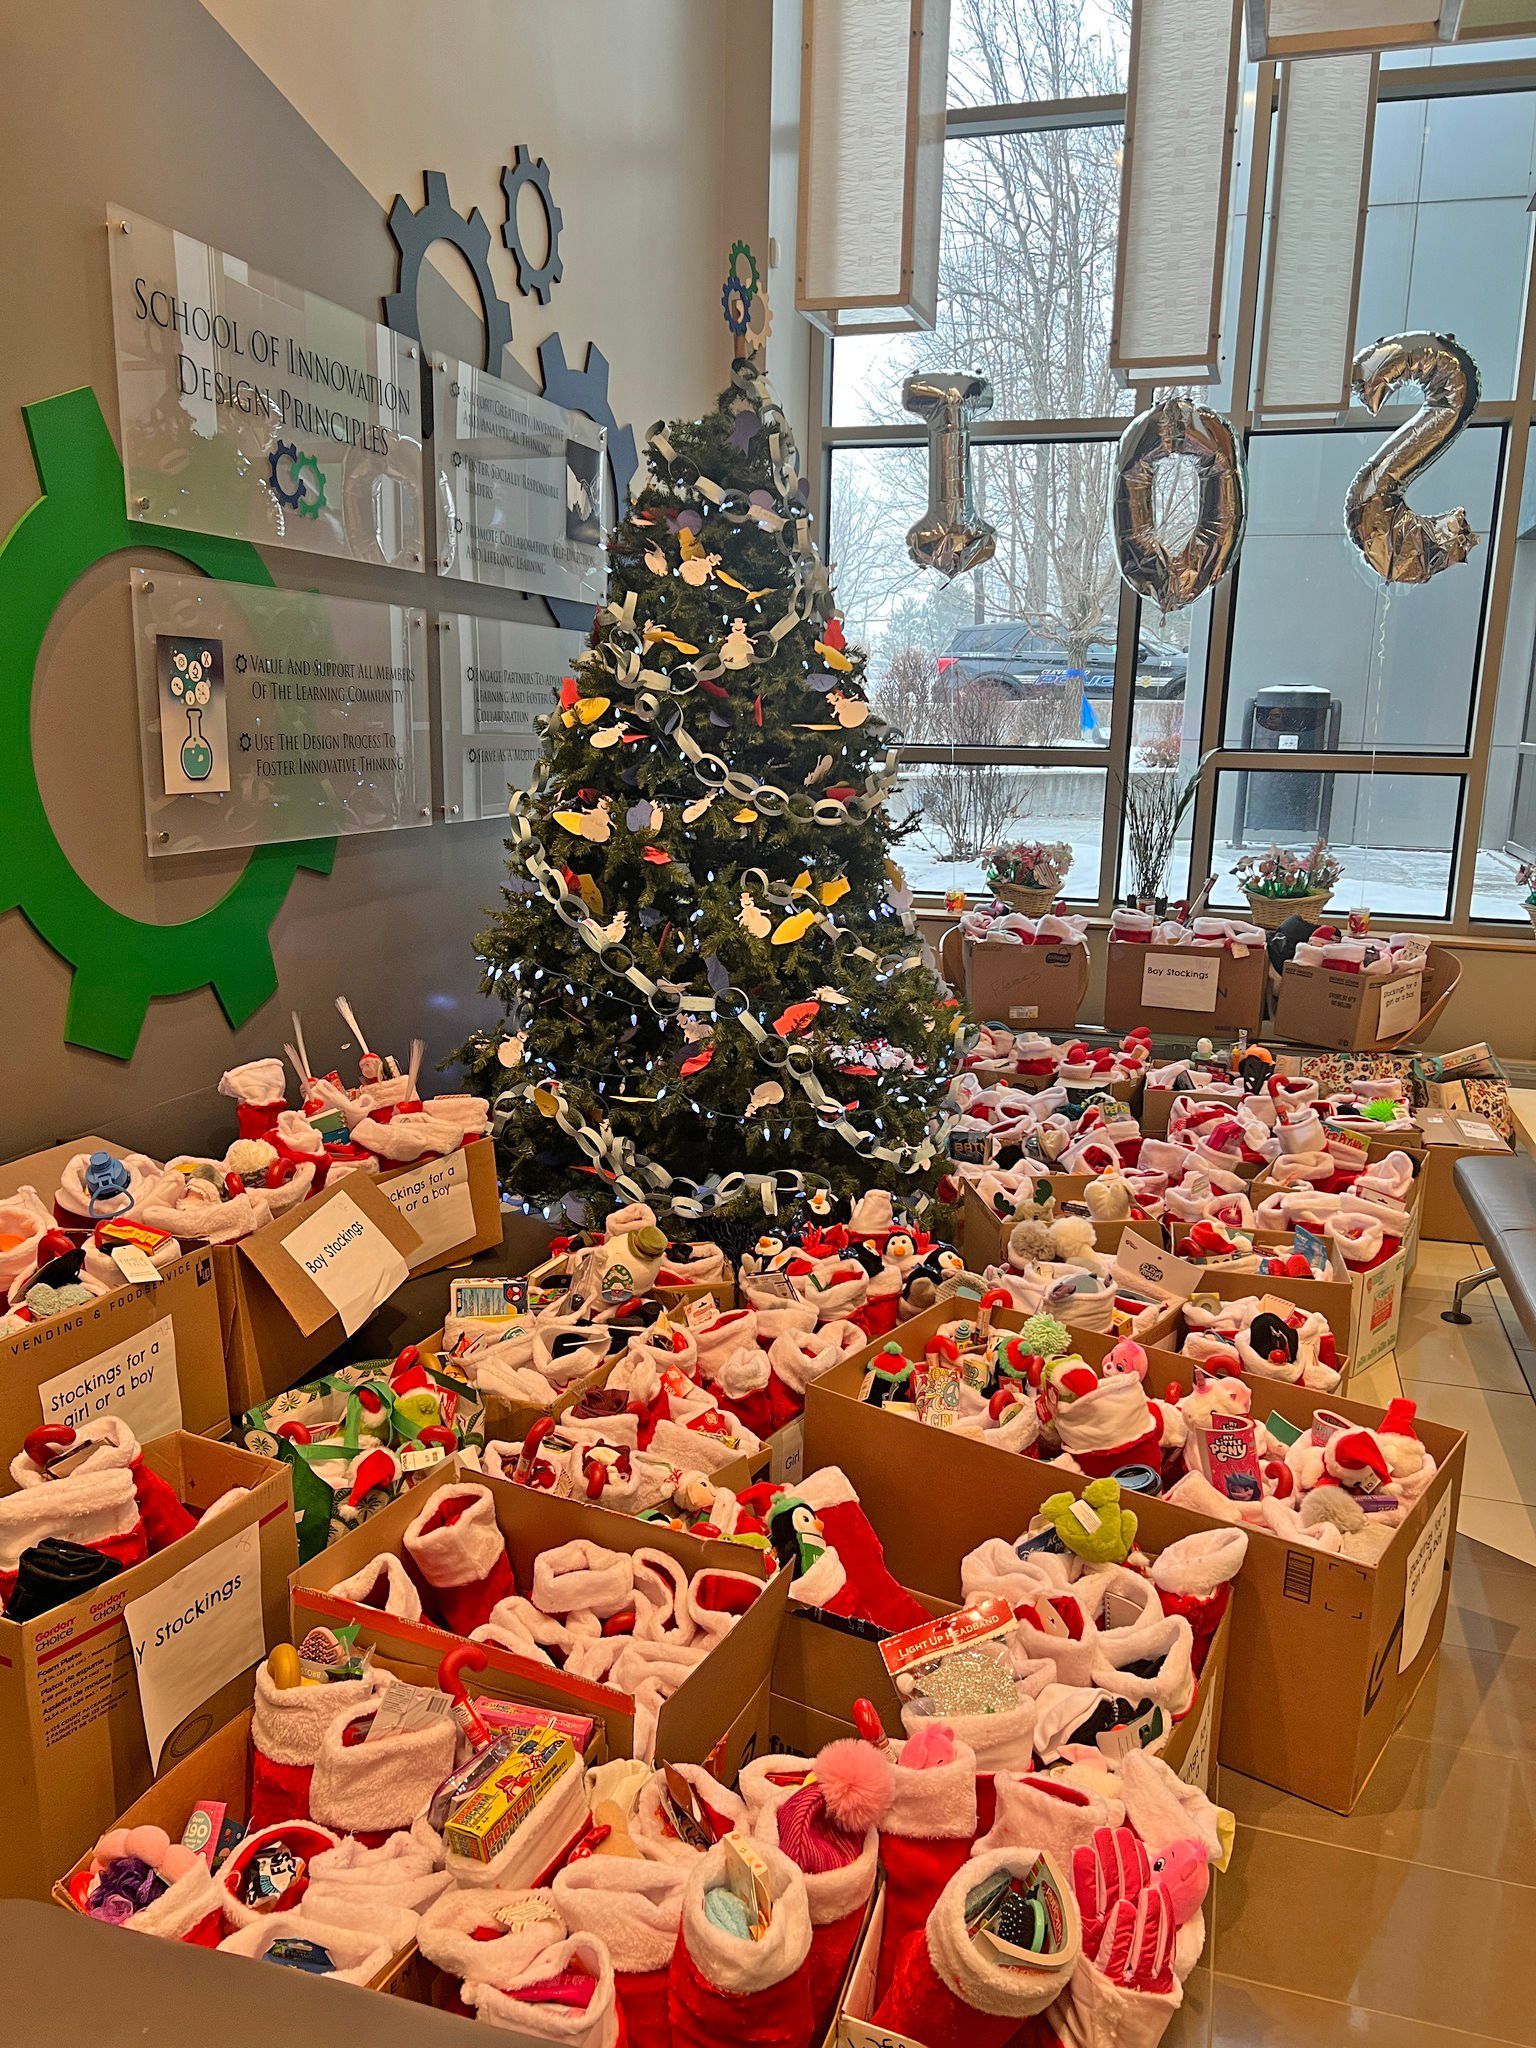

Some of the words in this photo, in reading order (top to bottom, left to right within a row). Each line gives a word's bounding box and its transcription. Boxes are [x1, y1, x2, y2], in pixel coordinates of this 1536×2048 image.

[134, 278, 244, 357] SCHOOL
[251, 329, 279, 368] OF
[288, 337, 411, 416] INNOVATION
[176, 353, 271, 421] DESIGN
[280, 388, 390, 456] PRINCIPLES
[522, 431, 552, 456] THINKING
[464, 454, 490, 478] FOSTER
[491, 463, 520, 487] SOCIALLY
[522, 474, 559, 499] RESPONSIBLE
[465, 522, 498, 542] PROMOTE
[482, 547, 515, 569] LIFELONG
[516, 557, 546, 575] LEARNING
[250, 655, 283, 674] VALUE
[287, 659, 311, 676] AND
[314, 659, 355, 678] SUPPORT
[358, 663, 374, 680] ALL
[374, 665, 416, 682] MEMBERS
[476, 667, 502, 683] ENGAGE
[503, 669, 534, 684] PARTNERS
[535, 671, 544, 685] TO
[1034, 674, 1115, 687] POLIC
[252, 681, 267, 700] OF
[271, 682, 292, 700] THE
[296, 683, 345, 702] LEARNING
[347, 686, 403, 704] COMMUNITY
[474, 688, 509, 704] LEARNING
[511, 690, 525, 704] AND
[526, 691, 548, 704] FOSTER
[476, 708, 529, 723] COLLABORATION
[254, 733, 274, 751] USE
[278, 733, 299, 750] THE
[303, 734, 340, 750] DESIGN
[343, 733, 381, 749] PROCESS
[384, 732, 396, 748] TO
[256, 759, 297, 776] FOSTER
[299, 757, 357, 774] INNOVATIVE
[359, 755, 404, 773] THINKING
[476, 749, 496, 763] SERVE
[499, 749, 507, 762] AS
[514, 749, 536, 761] MODEL
[1147, 967, 1164, 976] Boy
[1166, 968, 1209, 980] Stockings
[428, 1171, 443, 1185] for
[447, 1166, 454, 1176] a
[406, 1199, 418, 1212] or
[422, 1195, 429, 1204] a
[432, 1184, 451, 1199] boy
[305, 1253, 329, 1274] Boy
[323, 1221, 364, 1258] Stockings
[10, 1316, 84, 1356] VENDING
[93, 1310, 101, 1320] &
[51, 1364, 122, 1412] Stockings
[126, 1349, 146, 1370] for
[150, 1341, 159, 1354] a
[63, 1402, 90, 1428] girl
[95, 1393, 111, 1411] or
[116, 1384, 126, 1397] a
[130, 1366, 154, 1390] boy
[785, 1449, 799, 1470] Girl
[89, 1589, 128, 1615] Gordon
[93, 1601, 122, 1622] CHOIX
[155, 1575, 242, 1647] Stockings
[35, 1616, 77, 1643] Gordon
[898, 1640, 927, 1658] LIGHT
[928, 1635, 944, 1646] UP
[946, 1615, 999, 1640] HEADBAND
[37, 1664, 60, 1679] Foam
[60, 1651, 83, 1666] Plates
[40, 1682, 64, 1696] Platos
[64, 1674, 75, 1683] de
[76, 1659, 105, 1677] espuma
[42, 1695, 72, 1716] Assiette
[73, 1689, 83, 1698] de
[84, 1673, 112, 1691] mousse
[184, 1825, 208, 1838] 190
